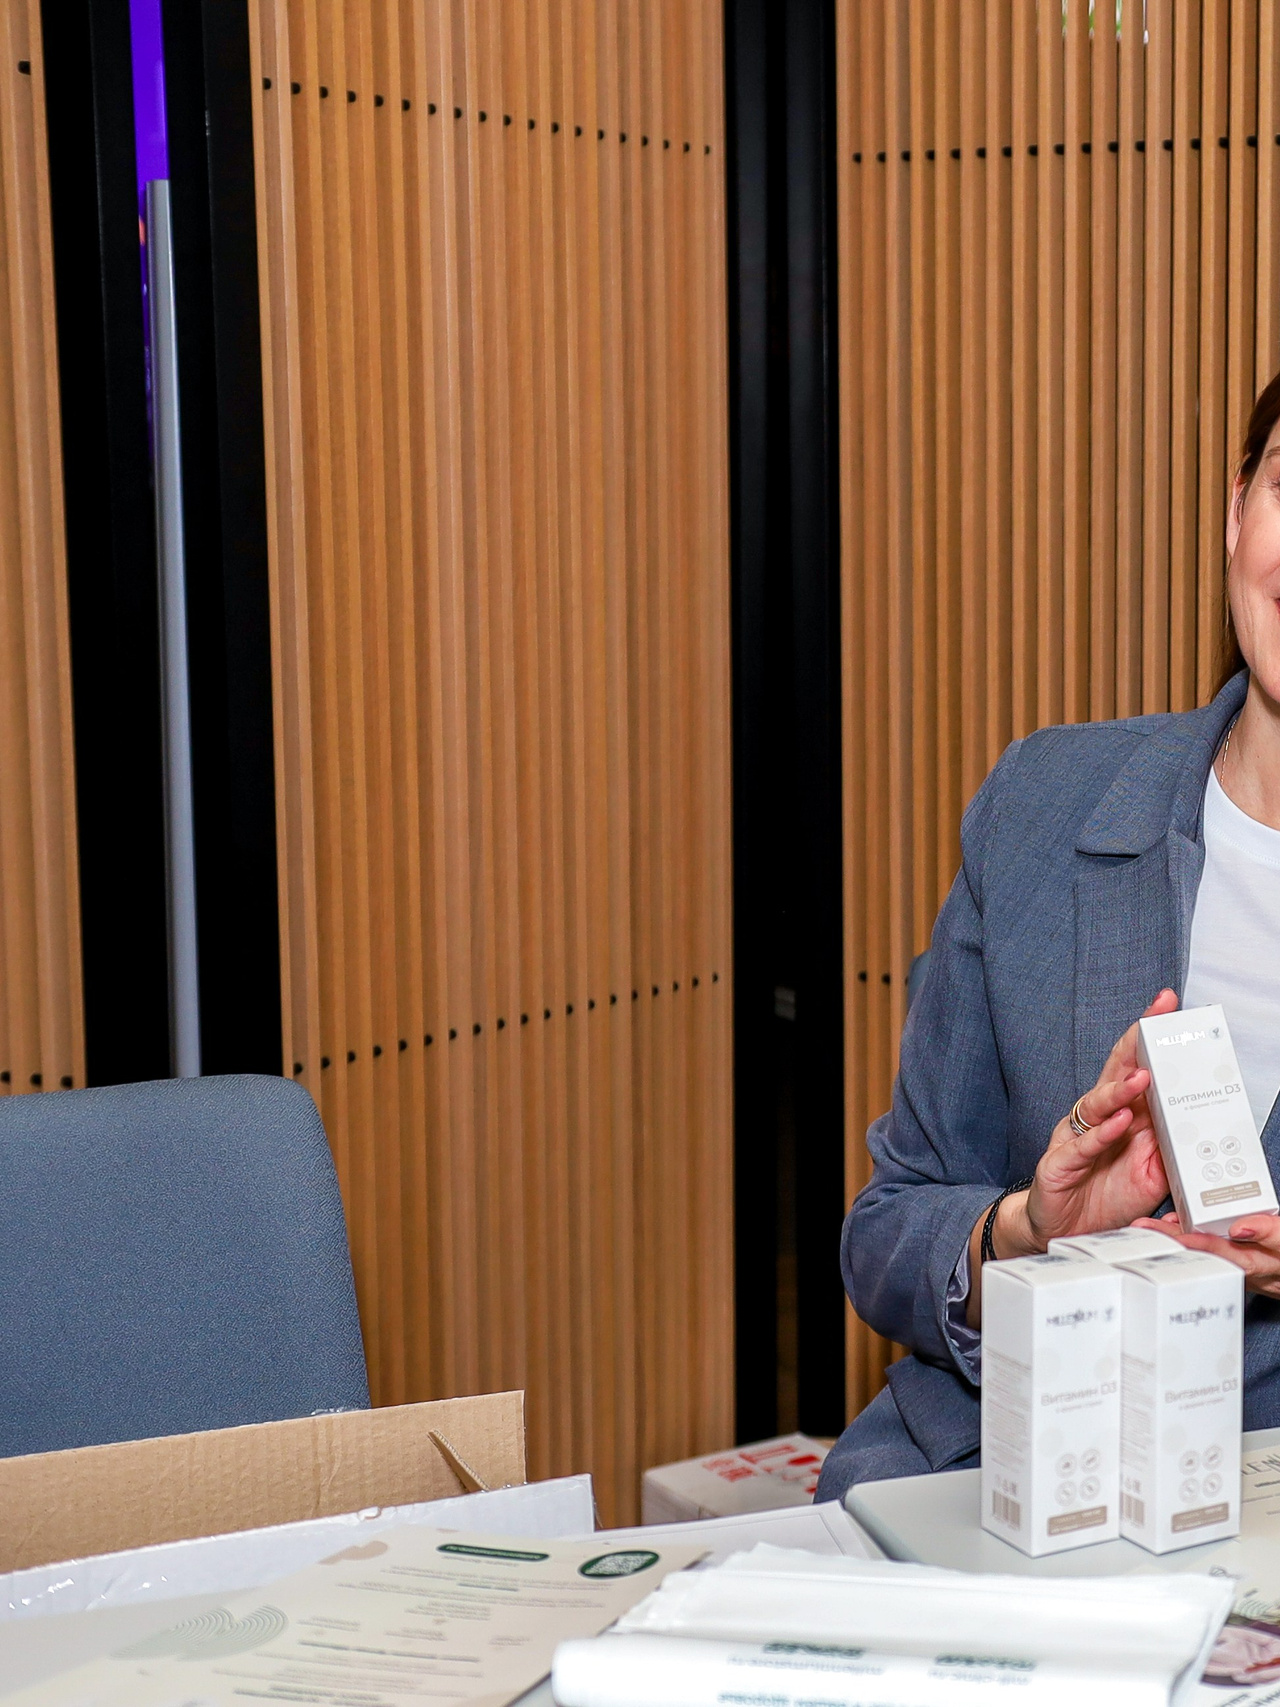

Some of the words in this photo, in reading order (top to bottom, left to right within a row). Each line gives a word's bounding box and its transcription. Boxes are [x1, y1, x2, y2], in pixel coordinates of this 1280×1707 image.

[1168, 1088, 1222, 1106] Витамин
[1224, 1083, 1241, 1095] D3
[1041, 1388, 1098, 1406] Витамин
[1101, 1382, 1117, 1395] D3
[1165, 1386, 1219, 1404] Витамин
[1222, 1379, 1238, 1392] D3
